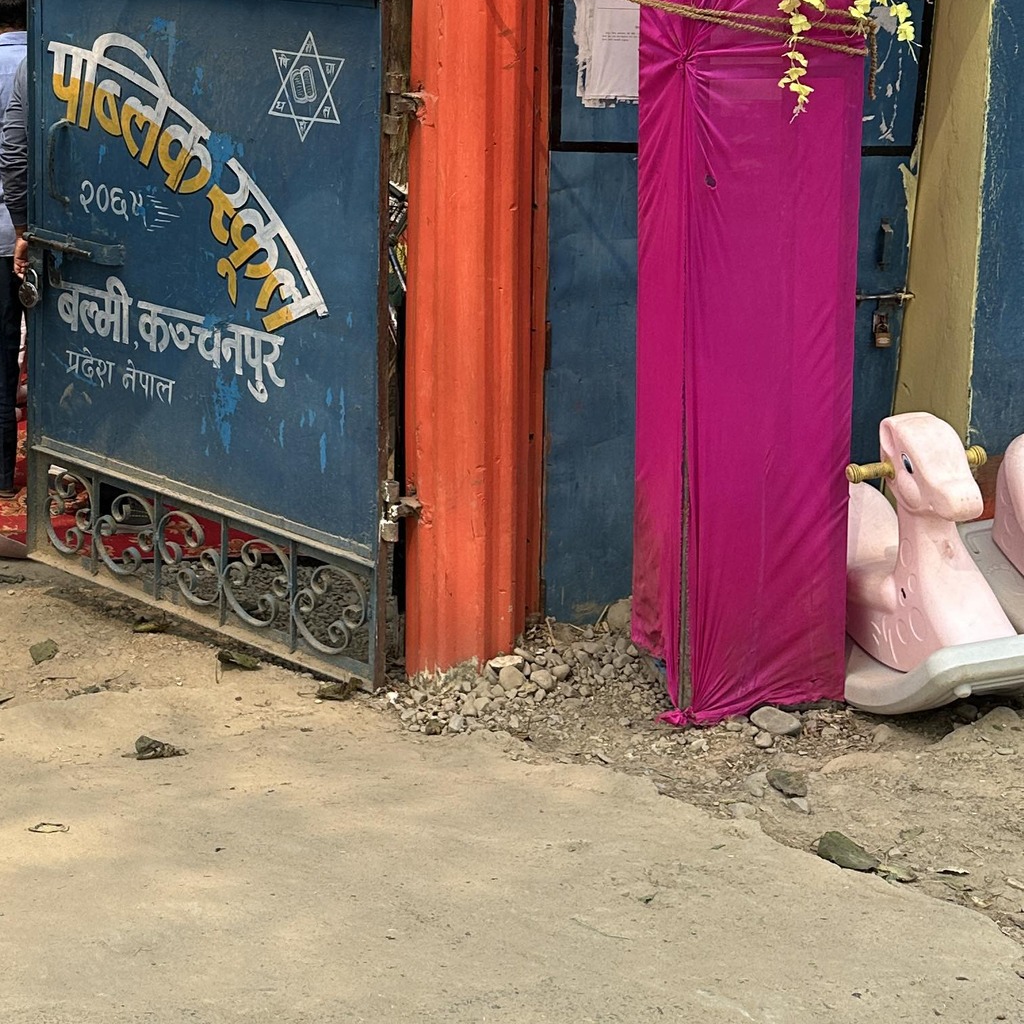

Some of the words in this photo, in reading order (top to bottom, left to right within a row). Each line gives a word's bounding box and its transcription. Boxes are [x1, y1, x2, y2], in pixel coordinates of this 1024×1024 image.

[47, 32, 212, 194] पब्लिक
[79, 180, 147, 229] २०६५
[65, 346, 116, 389] प्रदेश
[122, 358, 176, 406] नेपाल
[137, 301, 286, 404] कञ्चनपुर
